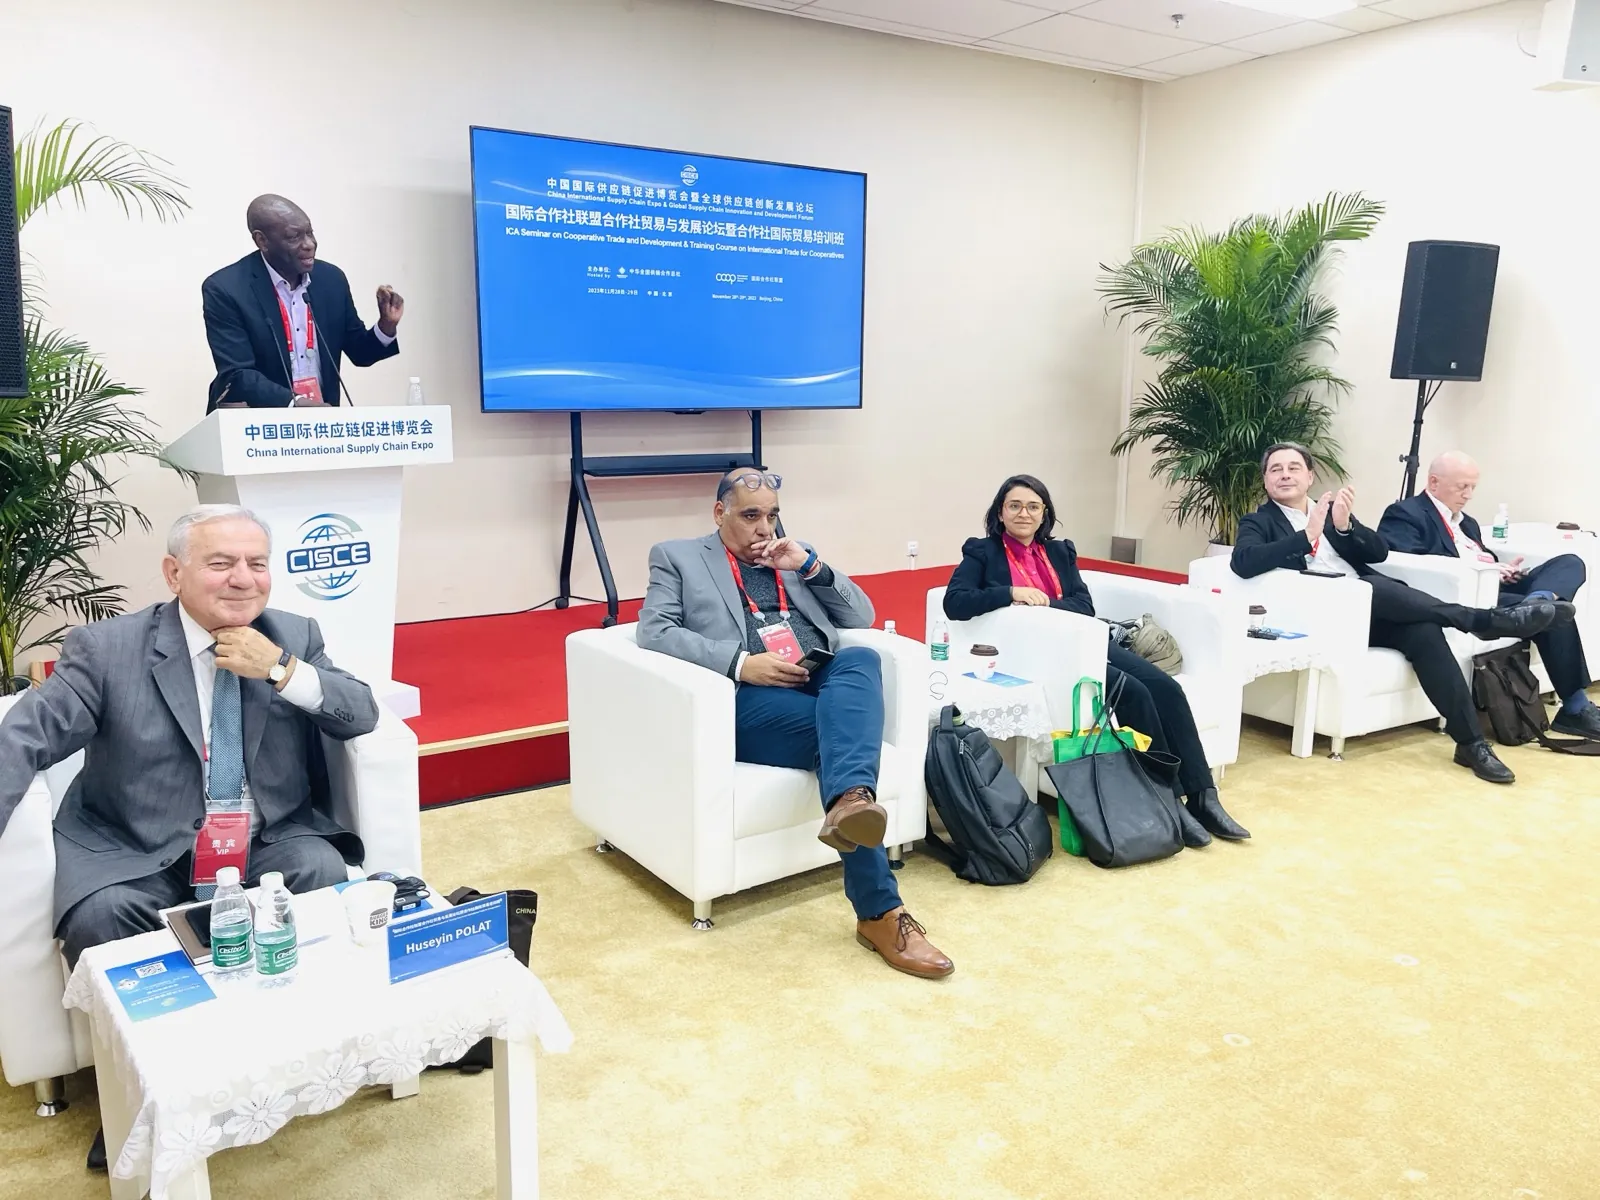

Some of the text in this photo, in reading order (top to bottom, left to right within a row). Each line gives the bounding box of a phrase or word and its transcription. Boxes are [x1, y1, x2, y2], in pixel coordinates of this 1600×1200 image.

[567, 193, 606, 202] International
[607, 196, 627, 205] Supply
[629, 198, 646, 206] Chain
[647, 199, 662, 207] Expo
[669, 202, 687, 210] Global
[688, 203, 707, 213] Supply
[708, 205, 725, 213] Chain
[725, 207, 753, 215] Innovation
[765, 211, 797, 219] Development
[505, 203, 845, 246] 国际合作社联盟合作社贸易与发展论坛暨合作社国际贸易培训班
[505, 227, 520, 236] ICA
[521, 228, 551, 238] Seminar
[563, 231, 605, 242] Cooperative
[606, 234, 625, 243] Trade
[626, 236, 639, 245] and
[640, 237, 682, 248] Development
[683, 240, 689, 248] &
[690, 240, 715, 252] Training
[715, 242, 738, 252] Course
[738, 245, 747, 253] on
[747, 245, 783, 255] International
[784, 247, 799, 256] Trade
[800, 248, 808, 257] for
[809, 249, 845, 259] Cooperatives
[245, 419, 433, 441] 中国国际供应链促进博览会
[246, 441, 434, 458] China International Supply Chain Expo
[290, 543, 369, 571] CISCE
[515, 907, 536, 915] CHINA
[406, 933, 453, 954] Huseyin
[456, 920, 492, 939] POLAT
